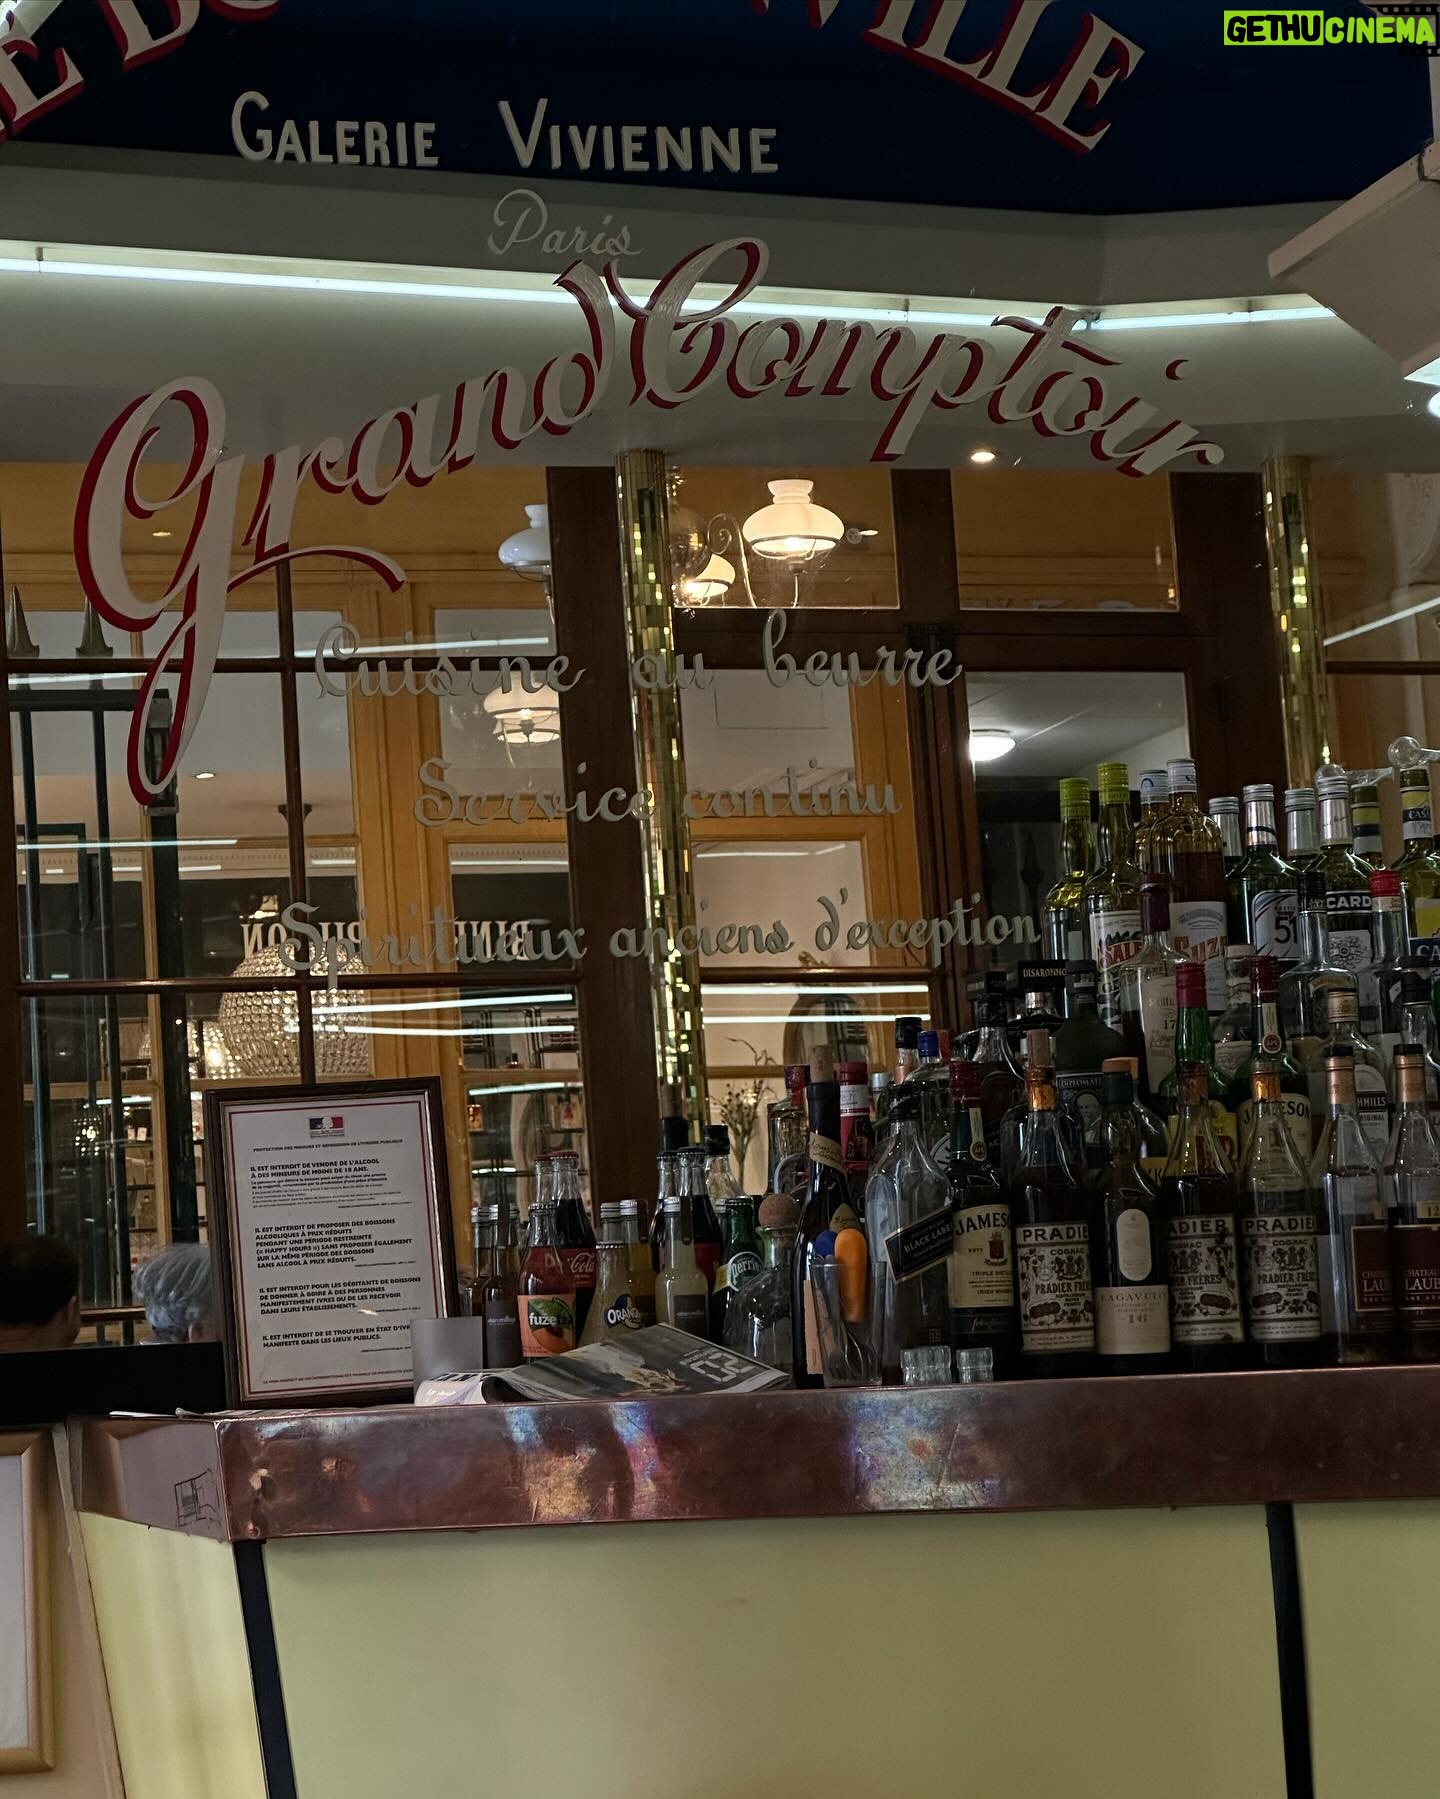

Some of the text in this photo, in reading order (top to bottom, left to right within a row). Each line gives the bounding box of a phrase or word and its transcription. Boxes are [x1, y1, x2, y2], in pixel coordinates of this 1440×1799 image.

[231, 91, 779, 174] GALERIE VIVIENNE
[487, 189, 643, 256] Paris
[603, 236, 1225, 477] Comptoir
[314, 608, 963, 698] Cuisine au beurre
[413, 757, 903, 827] Service continu
[1326, 895, 1372, 909] CARD
[278, 901, 588, 991] Spiritueux
[608, 900, 794, 958] anciens
[815, 888, 1042, 967] d'exception
[955, 1212, 1010, 1236] JAMES
[1022, 1226, 1088, 1242] PRADIE
[1245, 1217, 1313, 1233] PRADIE
